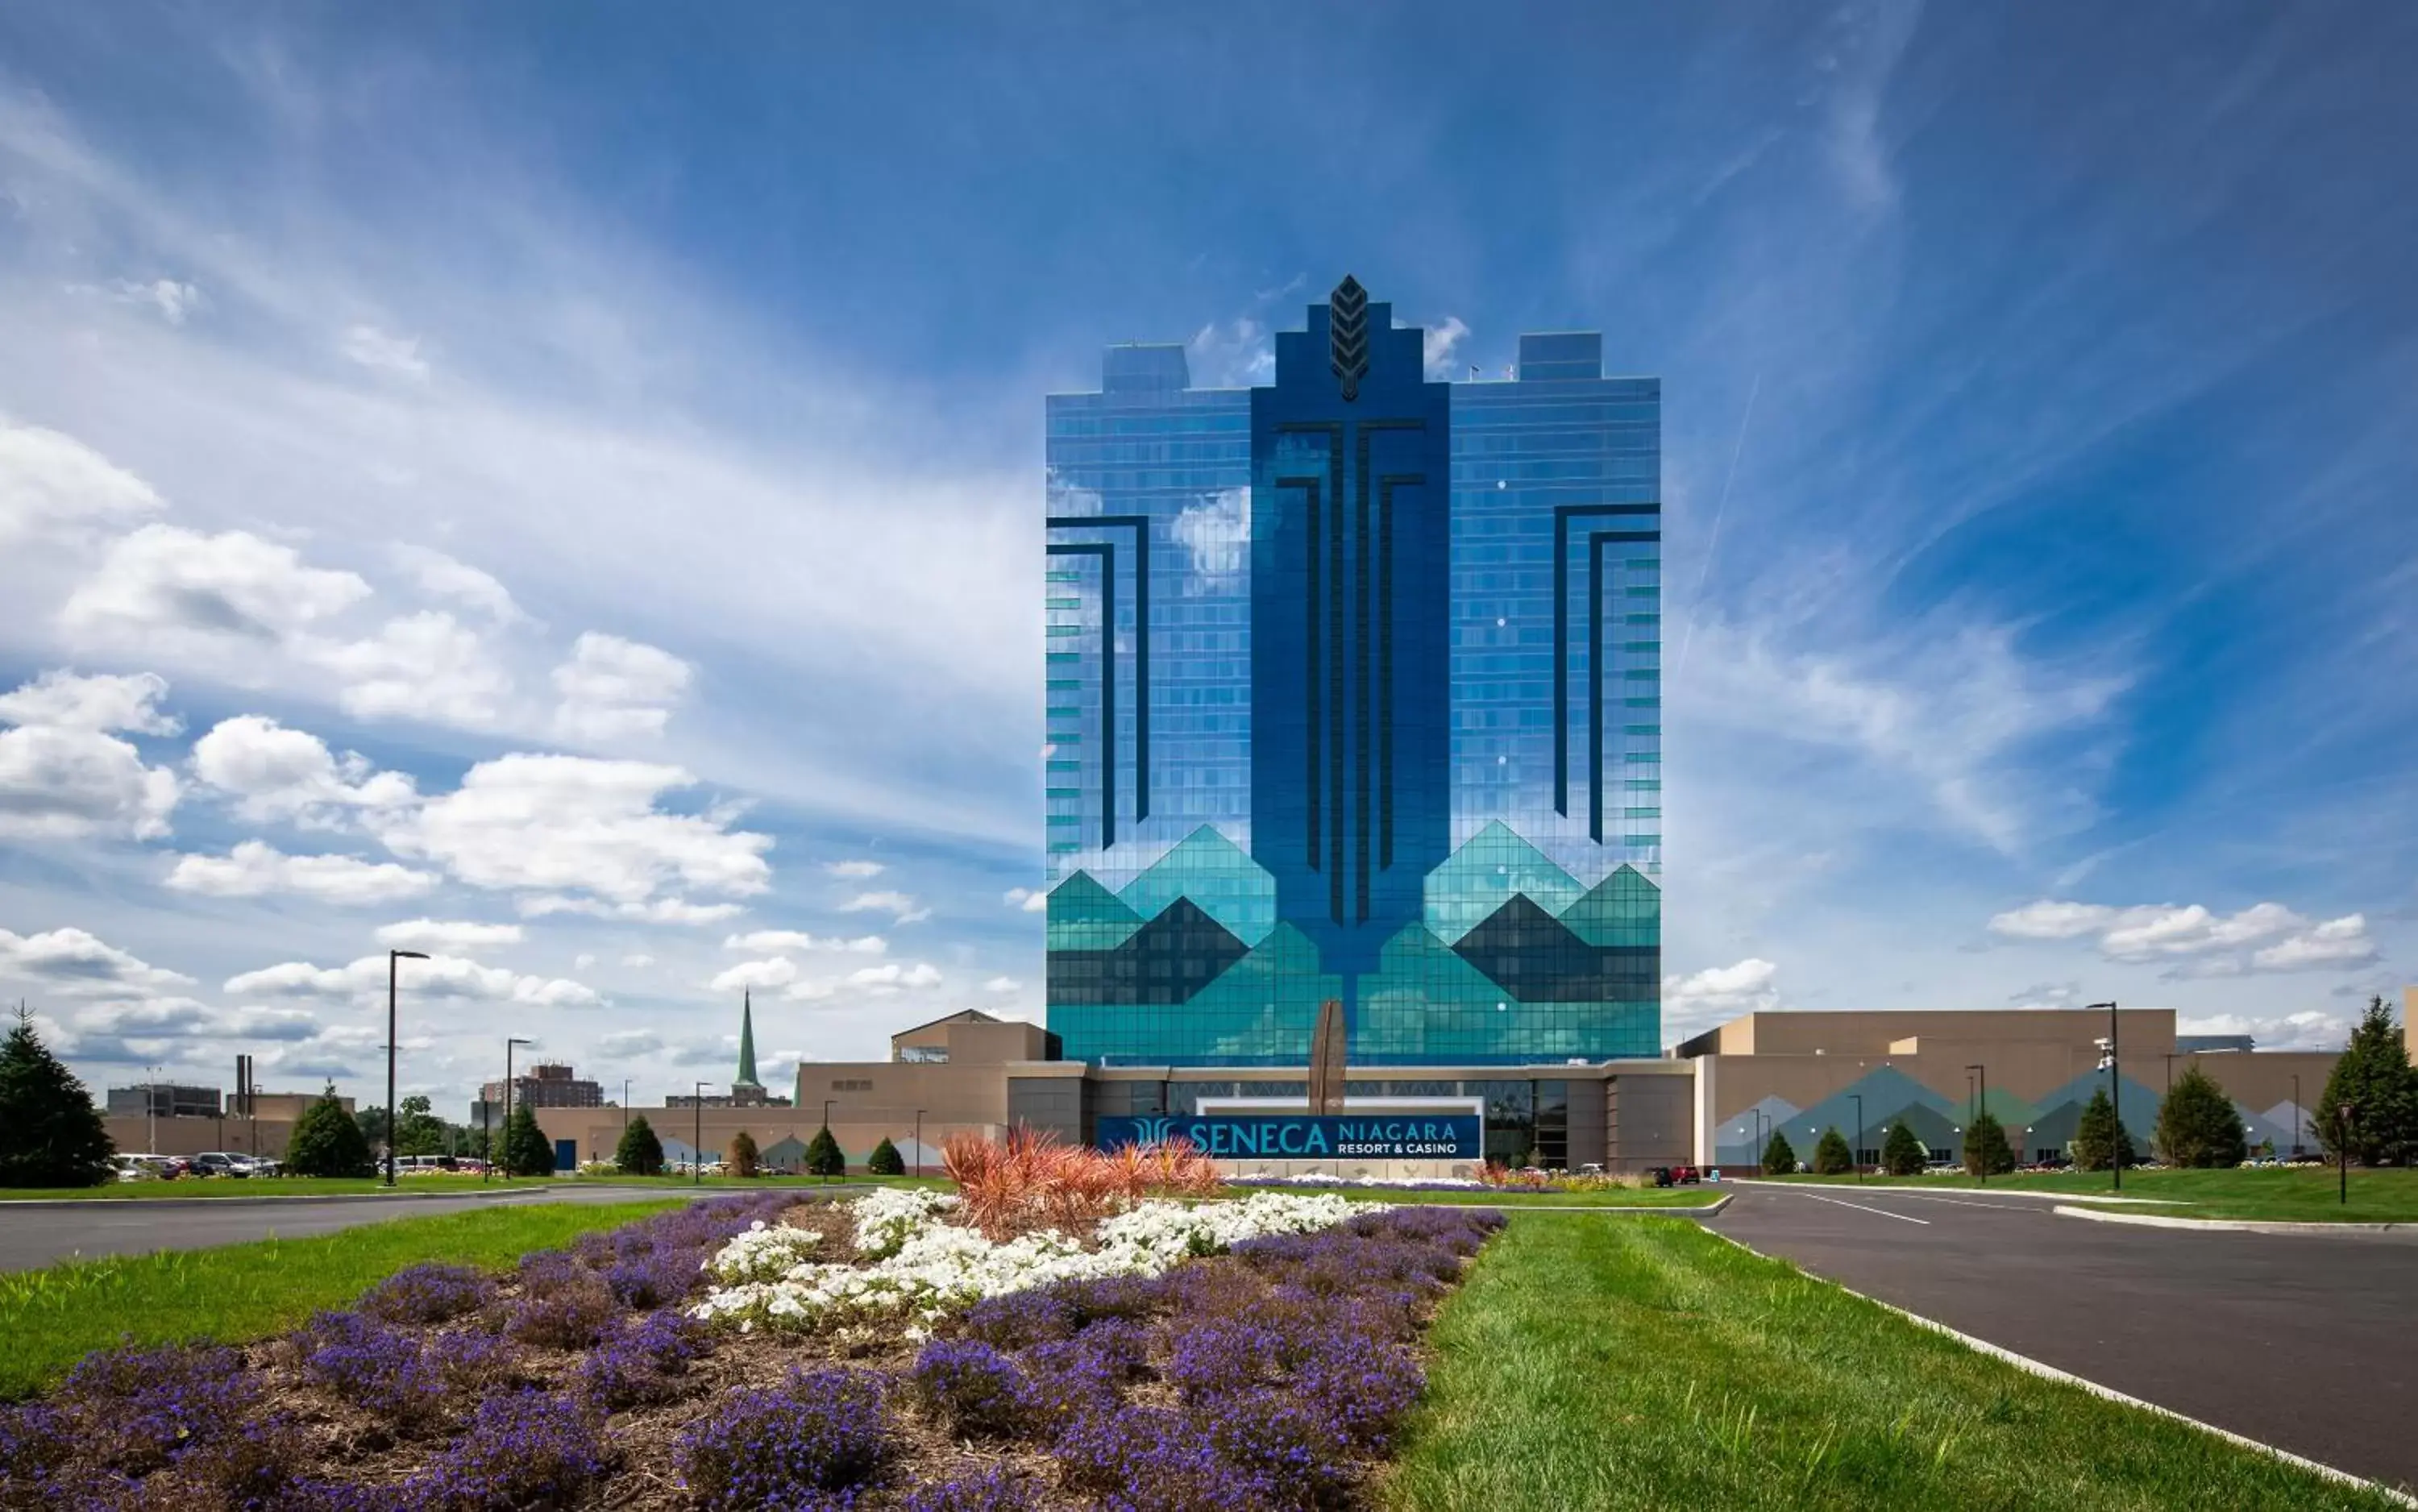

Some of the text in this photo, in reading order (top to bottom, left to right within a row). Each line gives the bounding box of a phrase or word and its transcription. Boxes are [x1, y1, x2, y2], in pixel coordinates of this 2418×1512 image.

[1190, 1123, 1456, 1153] SENECA NIAGARA
[1337, 1144, 1457, 1154] RESORT & CASINO
